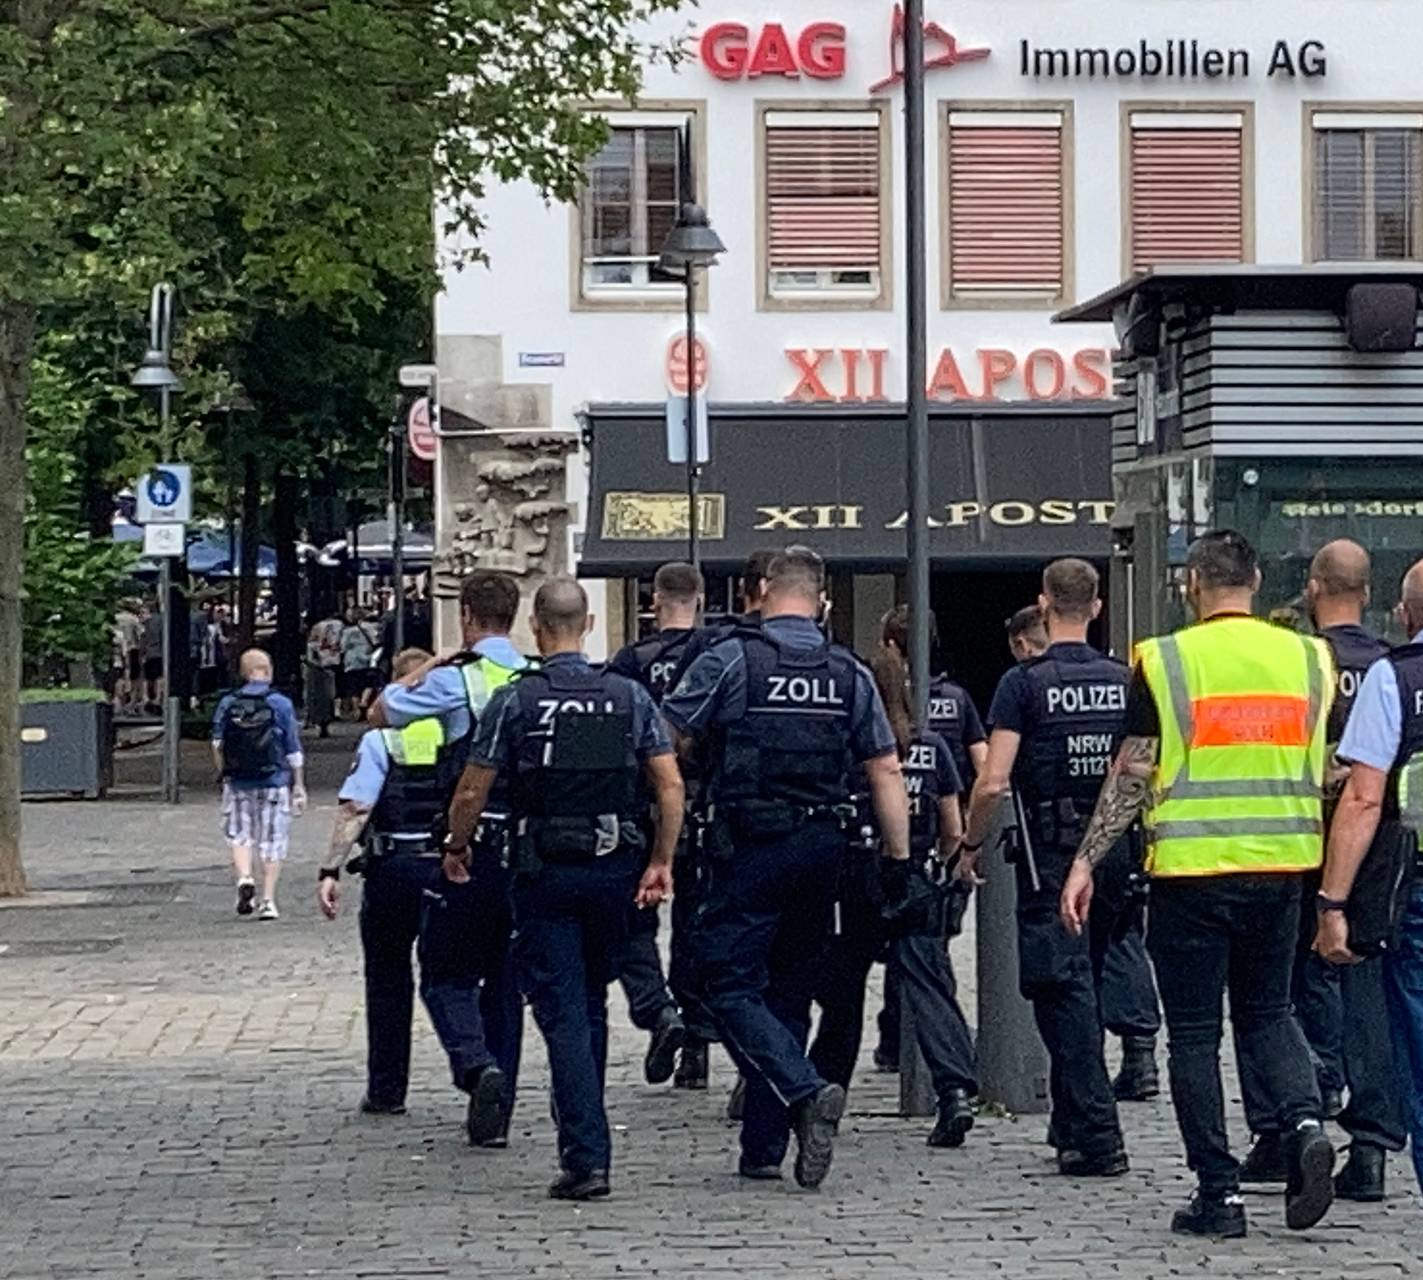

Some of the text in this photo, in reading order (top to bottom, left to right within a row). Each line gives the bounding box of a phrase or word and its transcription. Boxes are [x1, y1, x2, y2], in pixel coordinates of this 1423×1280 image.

[701, 22, 846, 80] GAG
[1020, 39, 1327, 78] Immobilien AG
[783, 348, 890, 401] XII
[753, 506, 863, 529] XII
[767, 676, 844, 704] ZOLL
[1047, 684, 1126, 713] POLIZEI
[1067, 733, 1112, 754] NRW
